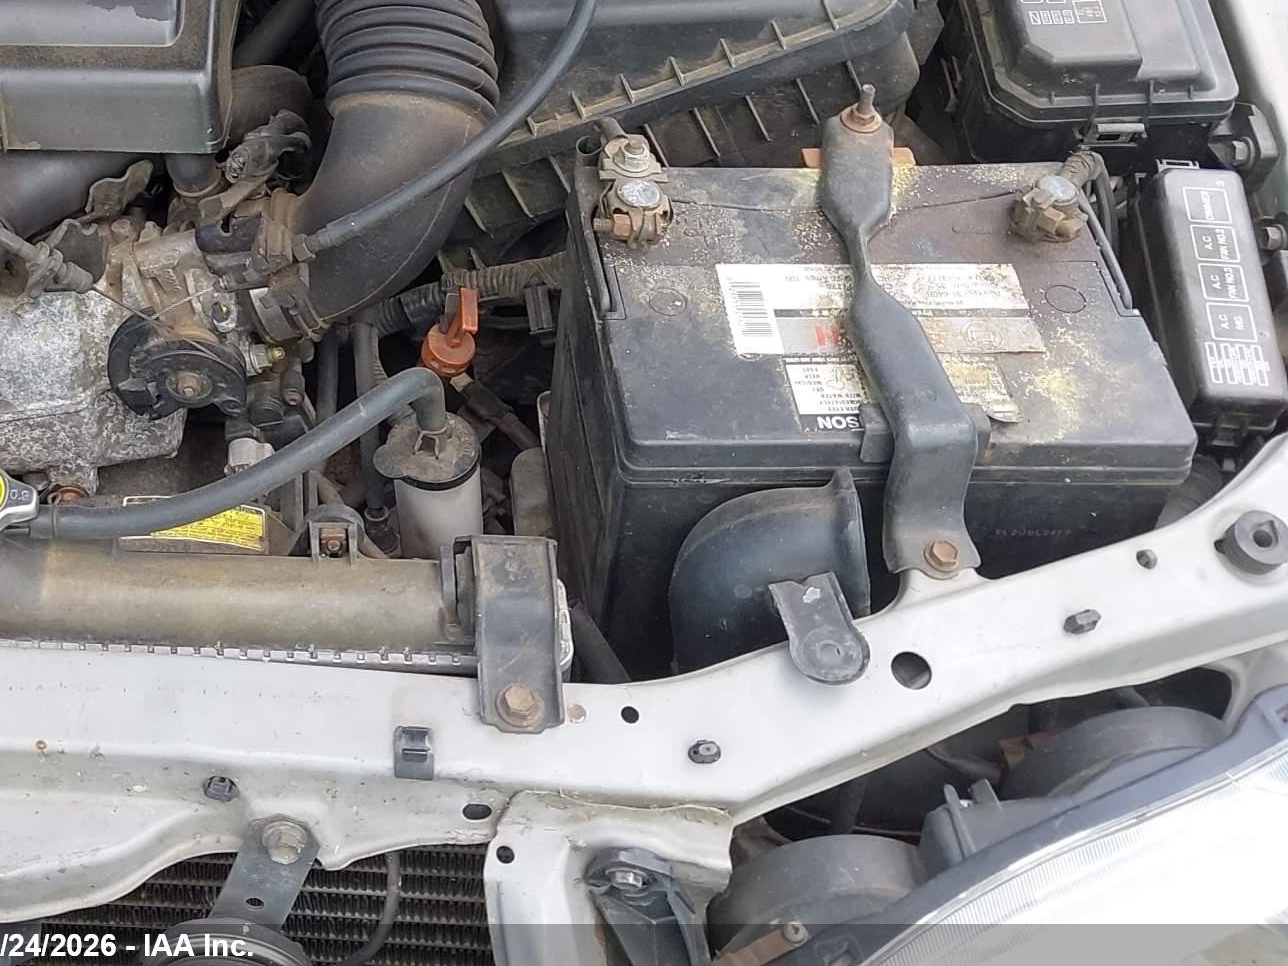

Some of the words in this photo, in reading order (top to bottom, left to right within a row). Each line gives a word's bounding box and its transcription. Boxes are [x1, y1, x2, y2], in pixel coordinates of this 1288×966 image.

[1227, 284, 1238, 299] FAN
[1218, 314, 1230, 330] A.C
[1234, 315, 1245, 331] MG
